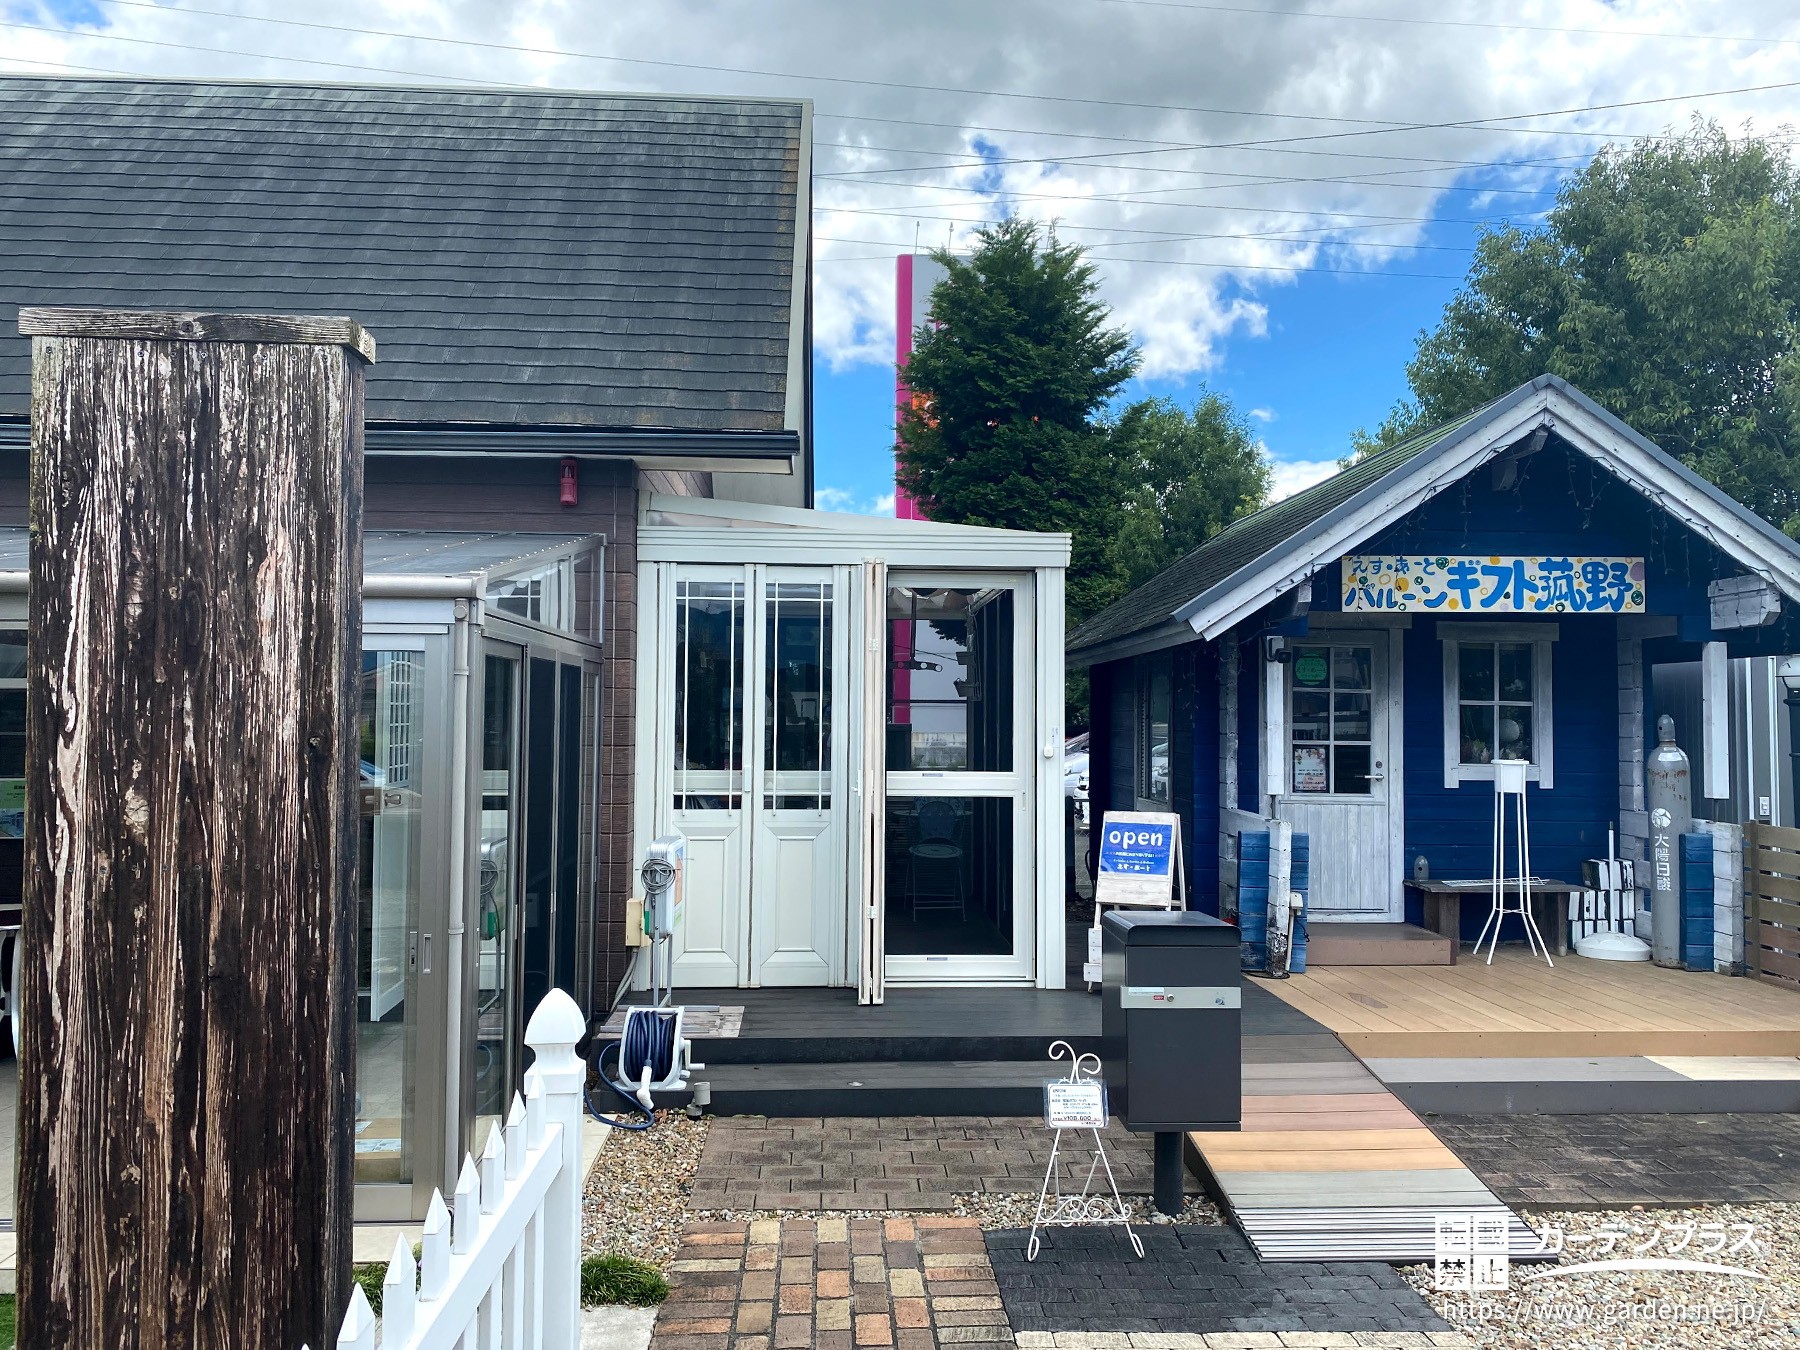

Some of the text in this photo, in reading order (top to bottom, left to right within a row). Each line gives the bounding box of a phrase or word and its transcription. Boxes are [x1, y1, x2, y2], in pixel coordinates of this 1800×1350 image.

[1352, 556, 1436, 576] えす・あーと
[1345, 582, 1448, 609] バルーン
[1109, 830, 1163, 849] open
